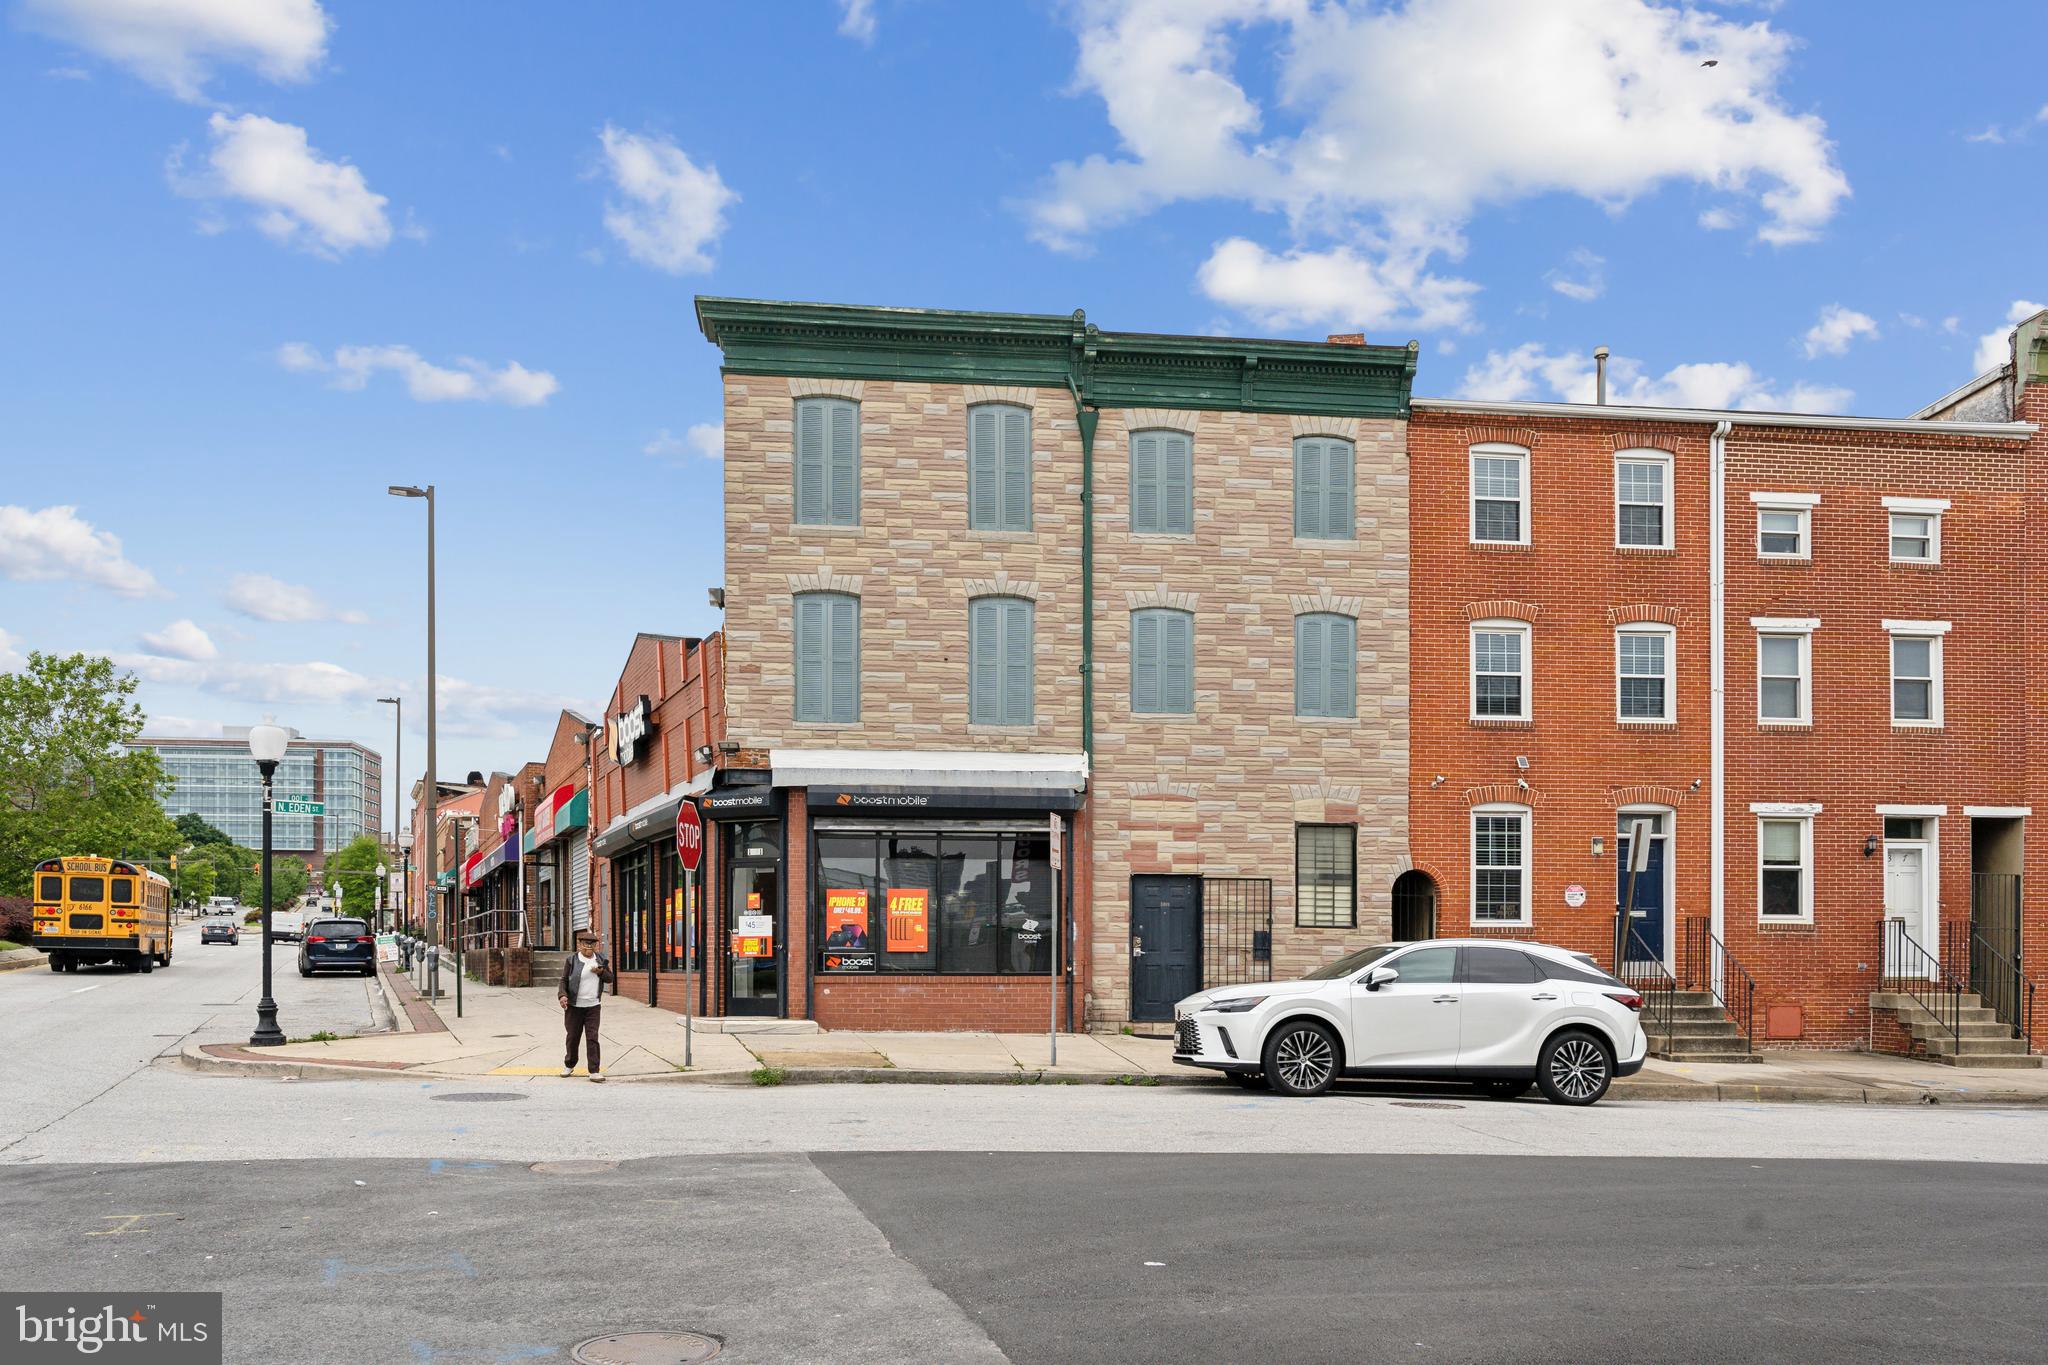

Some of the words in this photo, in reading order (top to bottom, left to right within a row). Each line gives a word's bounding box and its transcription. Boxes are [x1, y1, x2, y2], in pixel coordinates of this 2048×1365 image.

[713, 796, 763, 806] boostmobile
[853, 795, 928, 806] boostmobile
[288, 802, 311, 813] EDEN
[679, 822, 700, 849] STOP
[66, 862, 92, 872] SCHOOL
[94, 863, 107, 872] BUS
[829, 896, 856, 907] IPHONE
[857, 896, 866, 907] 13
[890, 896, 898, 911] 4
[898, 897, 924, 911] FREE
[841, 957, 873, 966] boost
